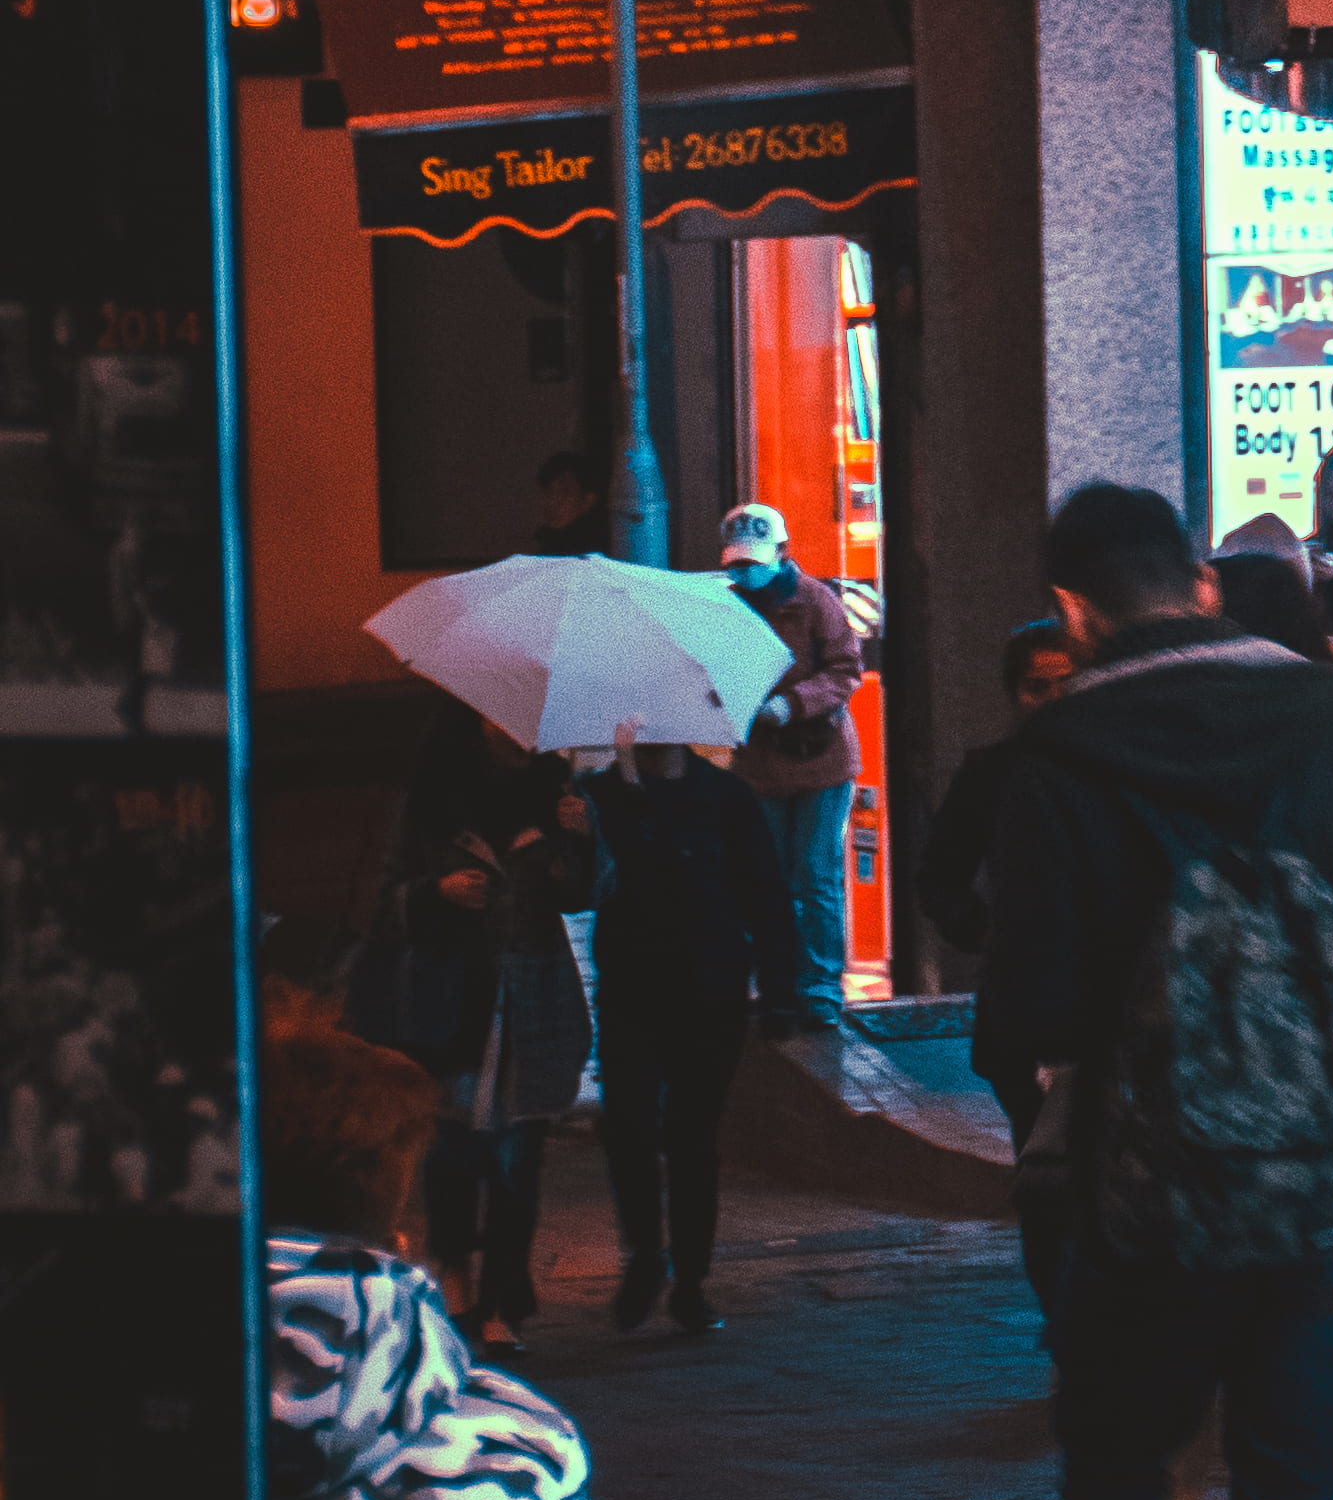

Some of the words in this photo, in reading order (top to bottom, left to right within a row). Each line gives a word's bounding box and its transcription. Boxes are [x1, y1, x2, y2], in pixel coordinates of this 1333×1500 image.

[421, 155, 493, 200] Sing
[495, 146, 594, 189] Tailor
[1234, 381, 1297, 414] FOOT
[1235, 423, 1298, 463] Body
